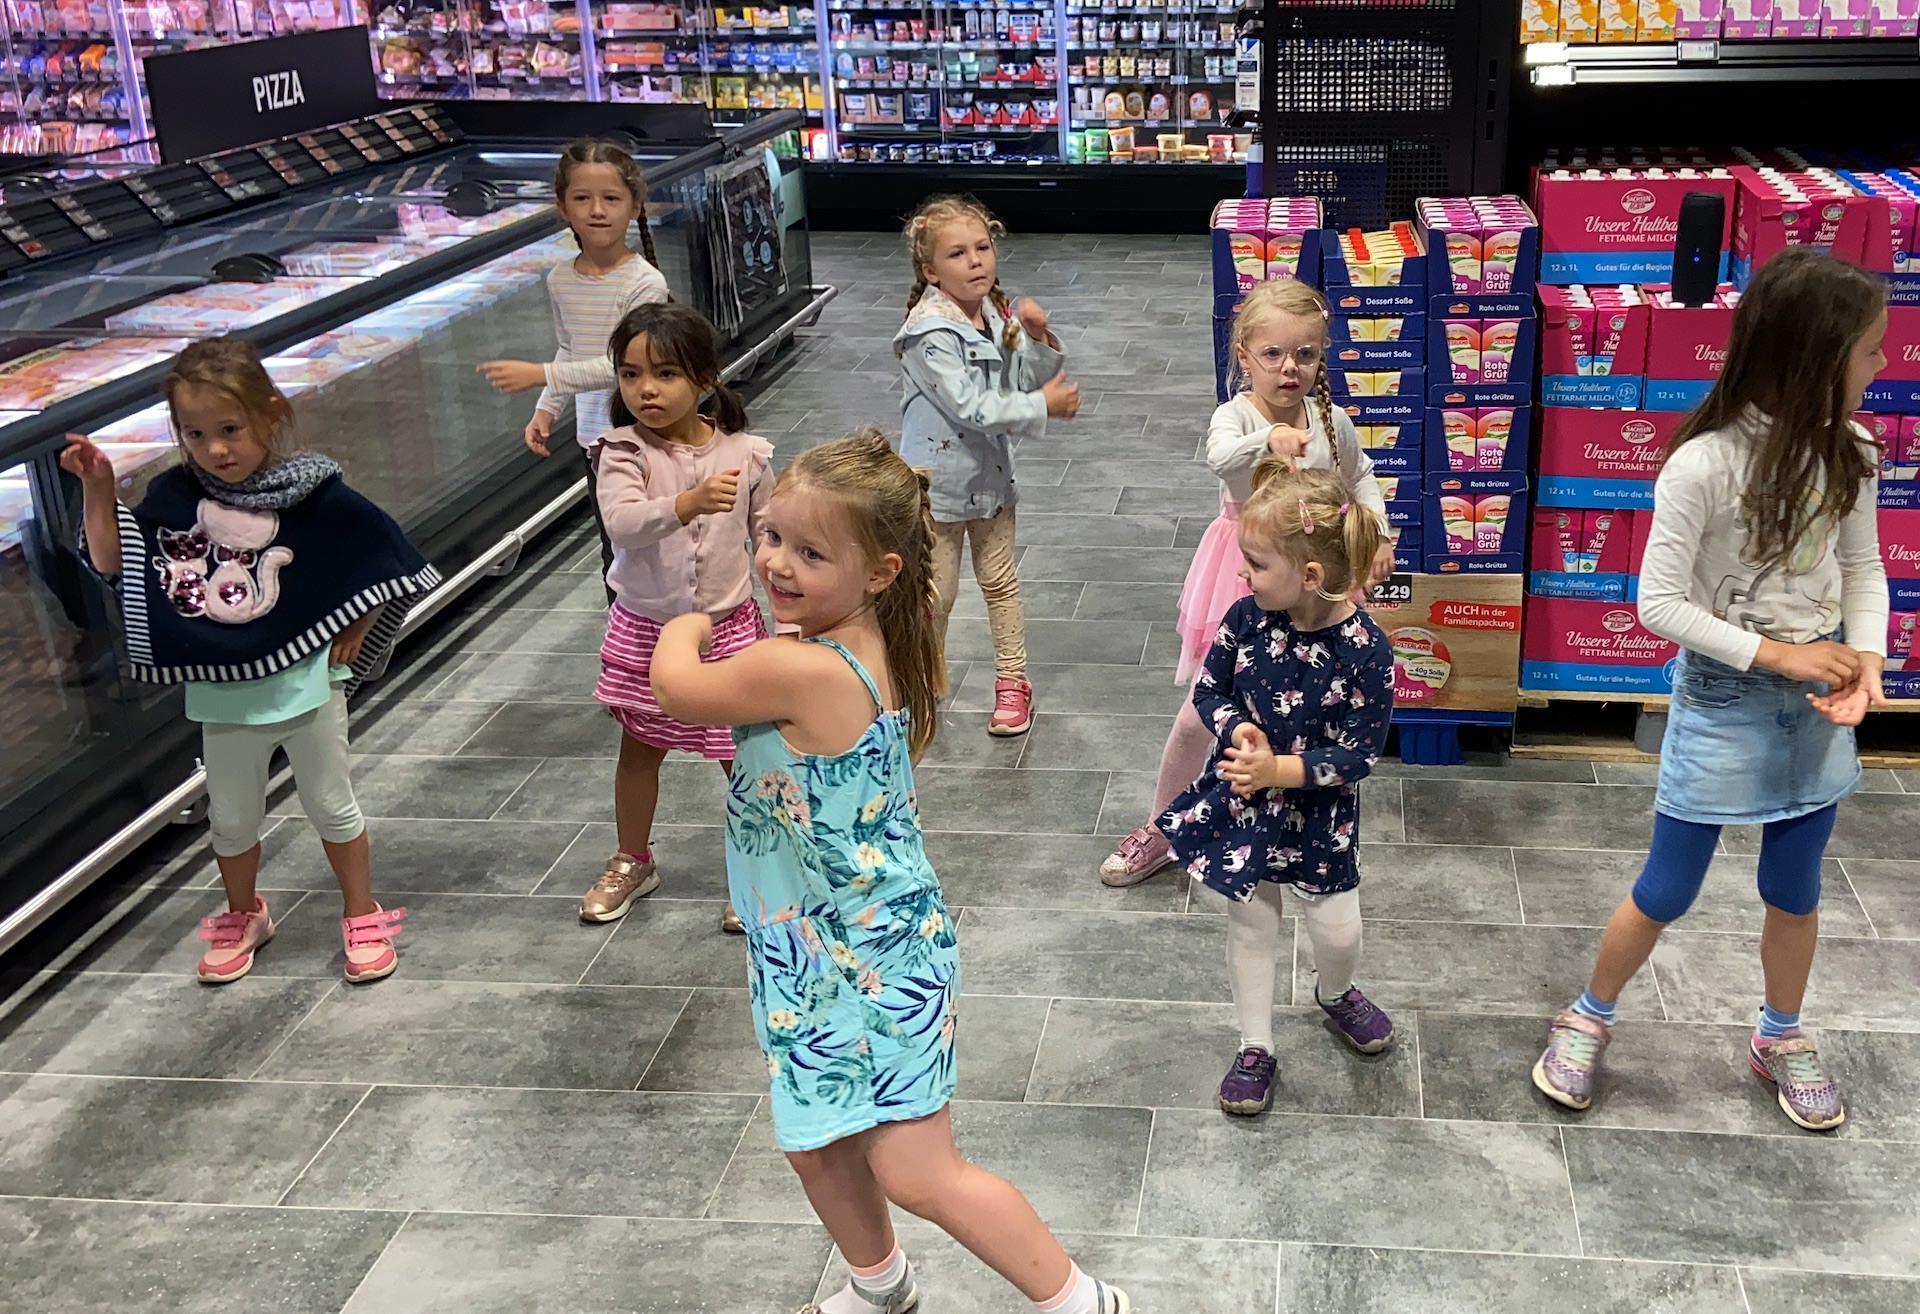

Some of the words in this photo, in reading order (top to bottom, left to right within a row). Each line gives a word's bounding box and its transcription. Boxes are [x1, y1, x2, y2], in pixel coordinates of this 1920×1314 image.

[253, 70, 305, 112] PIZZA
[1584, 215, 1631, 233] Unsere
[1631, 215, 1679, 234] Haltba
[1599, 234, 1646, 243] FETTARME
[1647, 233, 1678, 242] MILCH
[1646, 264, 1673, 273] Region
[1486, 272, 1509, 281] Rote
[1485, 281, 1512, 290] Grüt
[1394, 297, 1414, 305] Soße
[1888, 293, 1919, 301] LMILCH
[1393, 350, 1412, 358] Soße
[1694, 344, 1729, 361] Unse
[1903, 344, 1920, 361] Un
[1484, 361, 1508, 370] Rote
[1484, 370, 1508, 379] Grüt
[1863, 391, 1874, 399] 12
[1480, 448, 1503, 457] Rote
[1583, 443, 1629, 460] Unsere
[1479, 456, 1503, 465] Grüt
[1598, 461, 1645, 471] FETTARME
[1548, 487, 1559, 495] 12
[1593, 489, 1616, 497] Gutes
[1630, 490, 1642, 498] die
[1478, 532, 1500, 540] Rote
[1477, 540, 1501, 549] Grüt
[1888, 543, 1920, 561] Unse
[1374, 585, 1411, 599] 2.29
[1444, 605, 1479, 615] AUCH
[1481, 607, 1490, 616] in
[1491, 609, 1507, 617] der
[1443, 616, 1515, 629] Familienpackung
[1565, 631, 1611, 648] Unsere
[1612, 633, 1669, 649] Haltbare
[1580, 649, 1625, 658] FETTARME
[1627, 650, 1656, 659] MILCH
[1576, 674, 1597, 682] Gutes
[1612, 675, 1624, 683] die
[1625, 676, 1650, 685] Region
[1394, 687, 1423, 698] rütze
